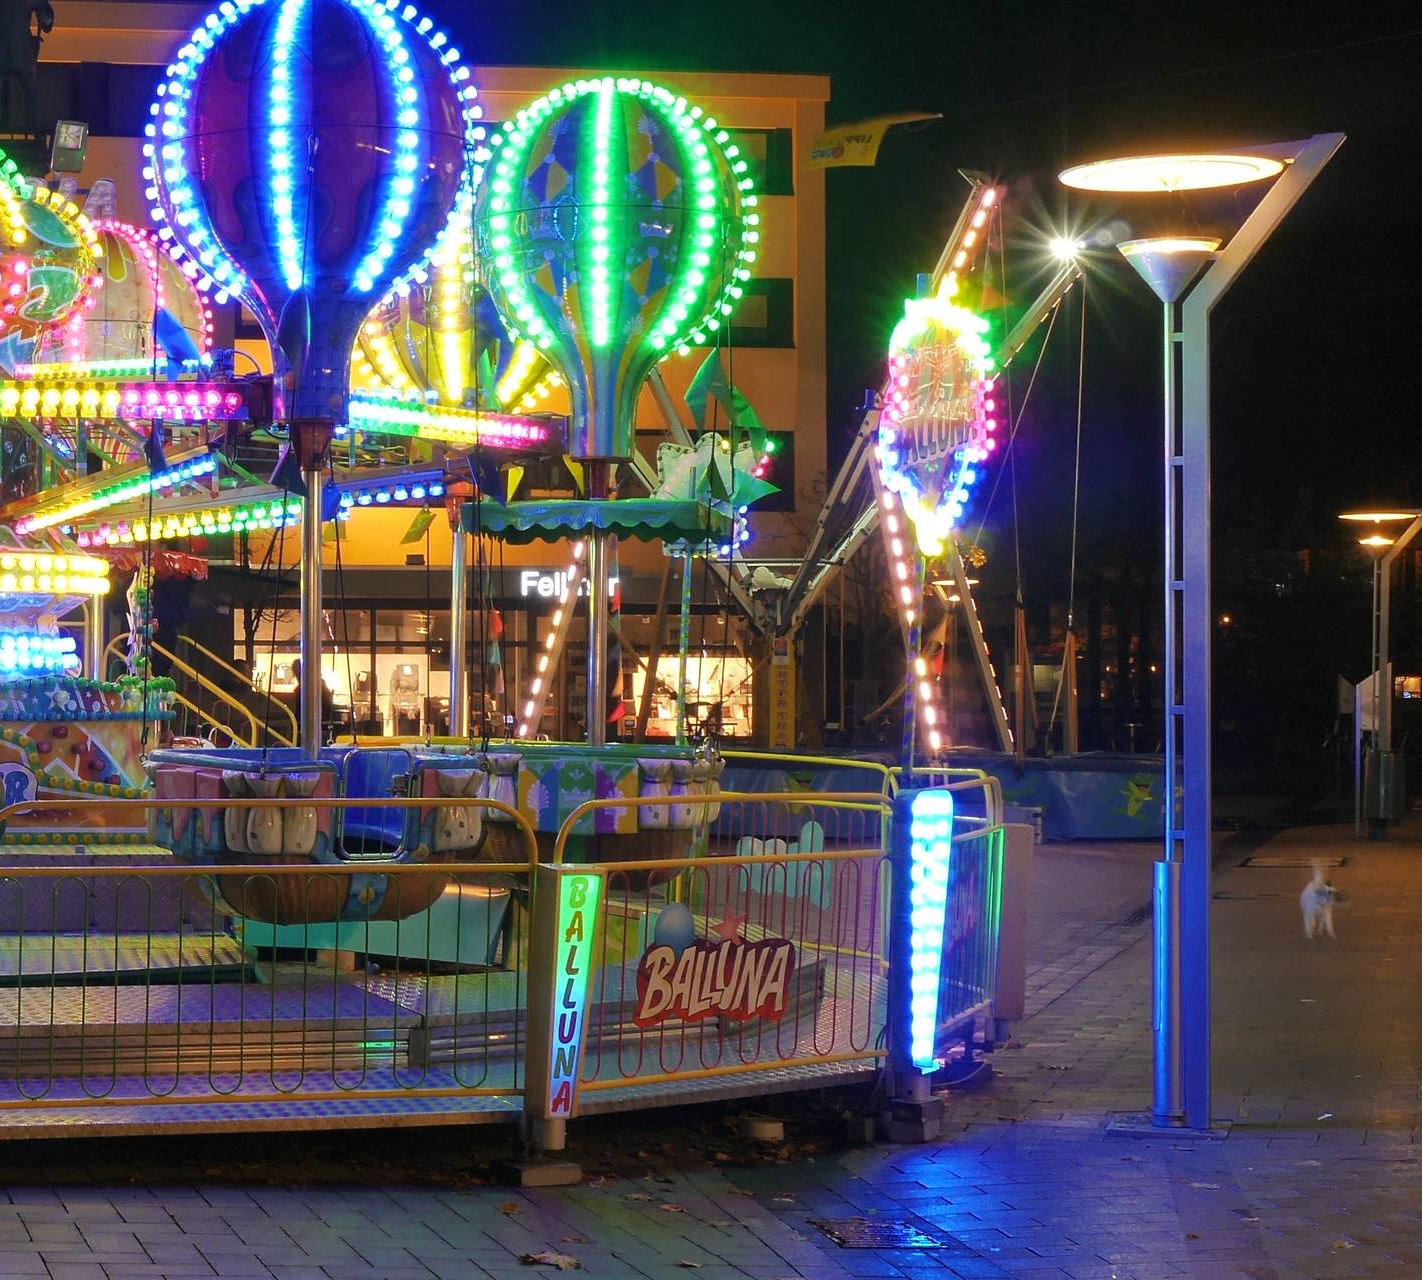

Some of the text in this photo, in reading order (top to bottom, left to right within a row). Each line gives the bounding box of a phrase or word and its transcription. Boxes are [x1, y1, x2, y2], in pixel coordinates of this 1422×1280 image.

[521, 571, 619, 597] Fellr
[551, 877, 589, 1112] BALLUNA
[640, 940, 790, 1019] BALLUNA
